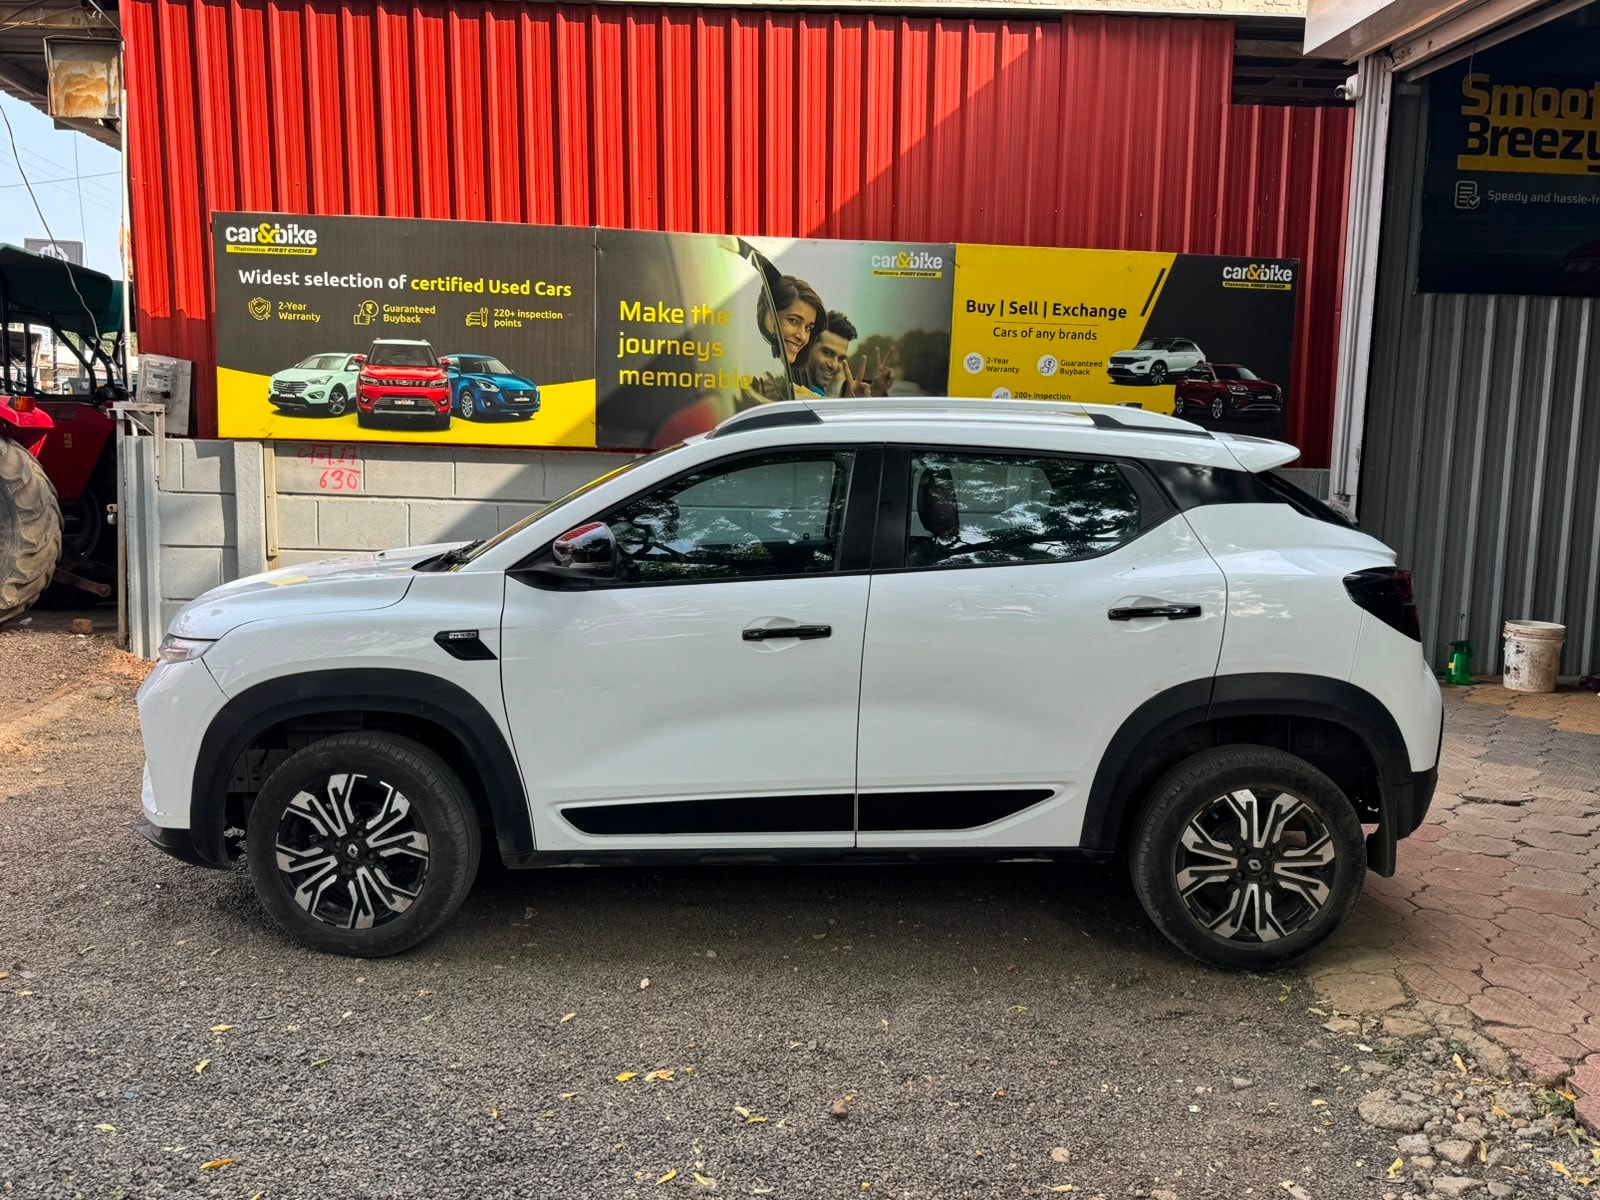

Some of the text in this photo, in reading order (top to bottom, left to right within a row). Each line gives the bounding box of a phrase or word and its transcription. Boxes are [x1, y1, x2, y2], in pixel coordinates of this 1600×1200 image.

[1487, 190, 1528, 204] Speedy
[1530, 192, 1550, 203] and
[225, 222, 318, 245] car&bike
[871, 251, 943, 270] car&bike
[1222, 263, 1293, 282] car&bike
[238, 269, 572, 297] Widest selection of certified Used Cars
[278, 302, 307, 311] 2-Year
[382, 303, 436, 315] Guaranteed
[619, 300, 731, 326] Make the
[966, 300, 996, 317] Buy
[1008, 301, 1039, 316] Sell
[1052, 302, 1128, 321] Exchange
[278, 312, 321, 323] Warranty
[383, 314, 422, 325] Buyback
[493, 308, 563, 321] 220+ inspection
[493, 318, 522, 329] points
[992, 327, 1098, 342] Cars of any brands
[617, 331, 725, 362] journeys
[985, 356, 1009, 365] 2-Year
[1060, 359, 1103, 369] Guaranteed
[985, 366, 1020, 375] Warranty
[1059, 368, 1090, 377] Buyback
[619, 367, 754, 391] memorable
[1014, 391, 1071, 401] 200+ inspection
[319, 468, 358, 490] 630
